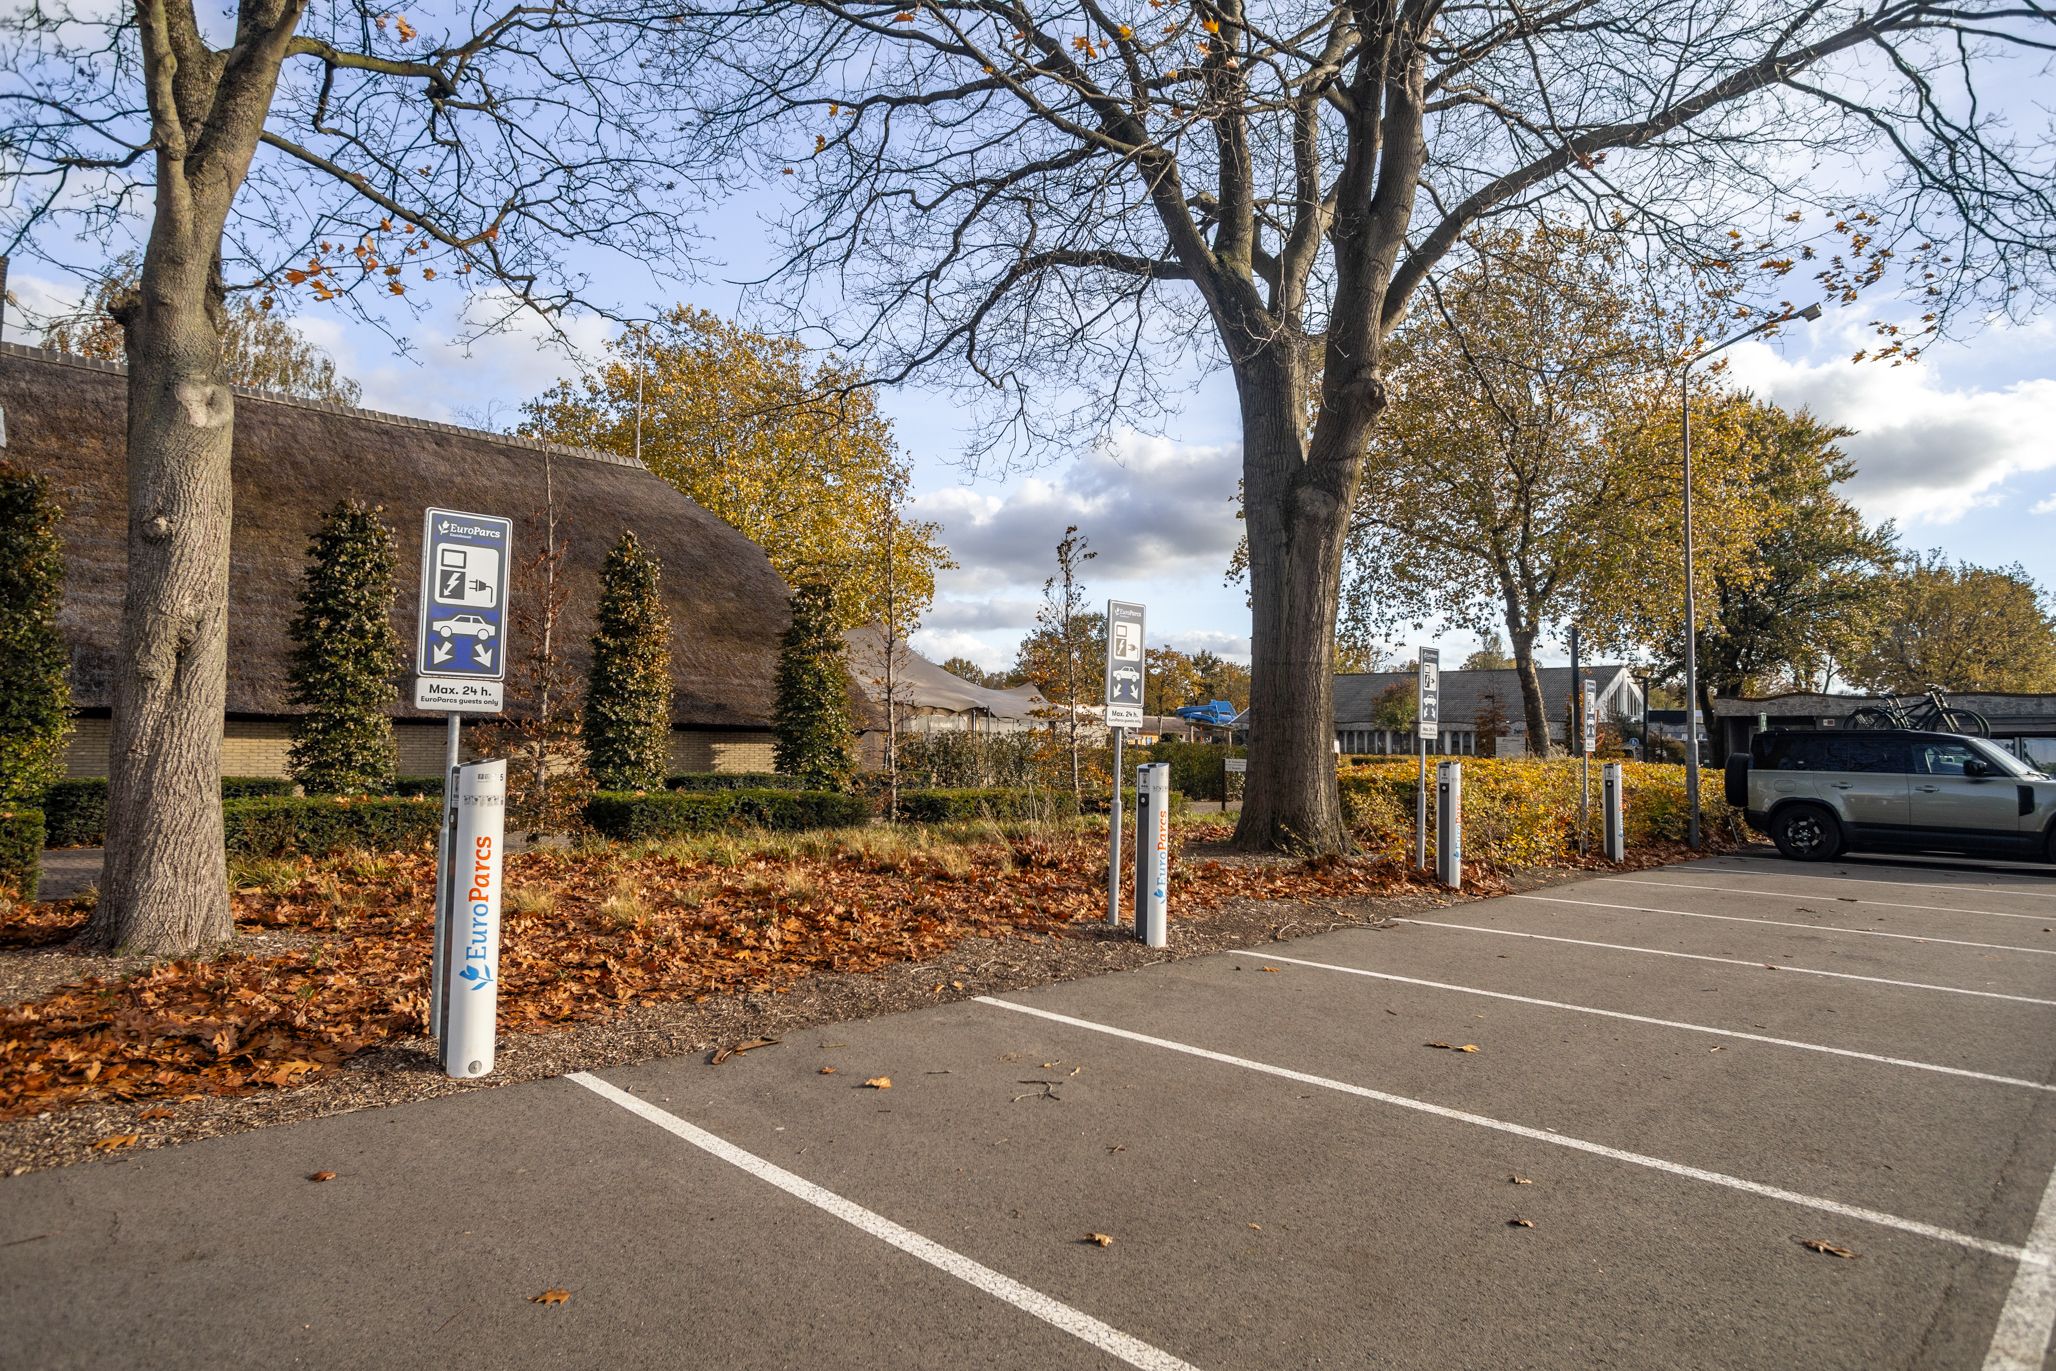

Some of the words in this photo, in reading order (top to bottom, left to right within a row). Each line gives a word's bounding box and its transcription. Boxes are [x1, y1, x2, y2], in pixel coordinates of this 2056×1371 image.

[450, 523, 500, 538] EuroParcs
[429, 684, 459, 695] Max.
[462, 685, 477, 696] 24
[481, 686, 492, 697] h.
[420, 695, 458, 704] EuroParcs
[458, 698, 482, 706] guests
[483, 698, 499, 707] only
[1156, 810, 1167, 886] EuroParcs
[466, 836, 492, 960] EuroParcs
